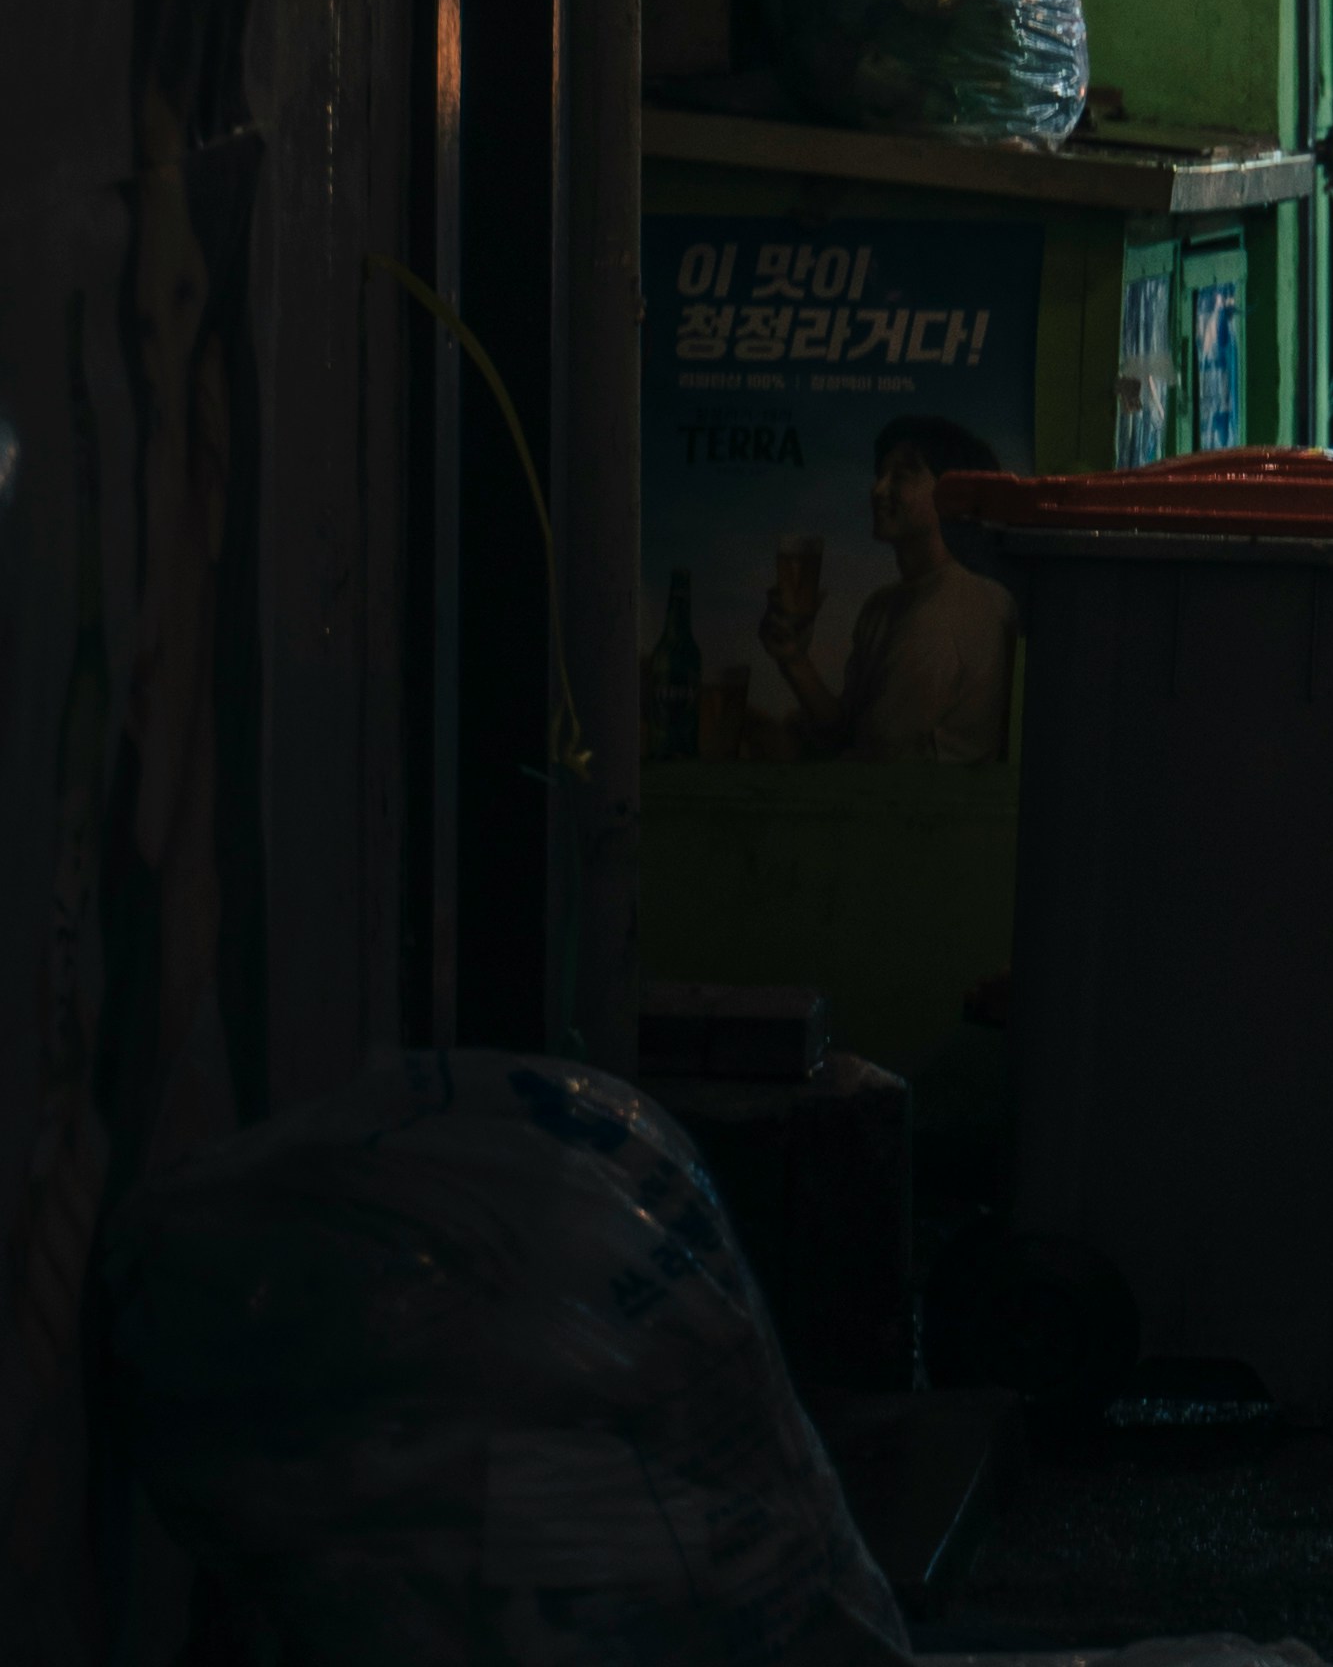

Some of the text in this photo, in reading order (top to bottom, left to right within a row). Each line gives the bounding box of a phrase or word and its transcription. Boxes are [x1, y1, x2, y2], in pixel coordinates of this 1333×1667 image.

[676, 242, 878, 303] 이 맛이
[675, 302, 992, 367] 청정라거다!
[677, 425, 806, 469] TERRA
